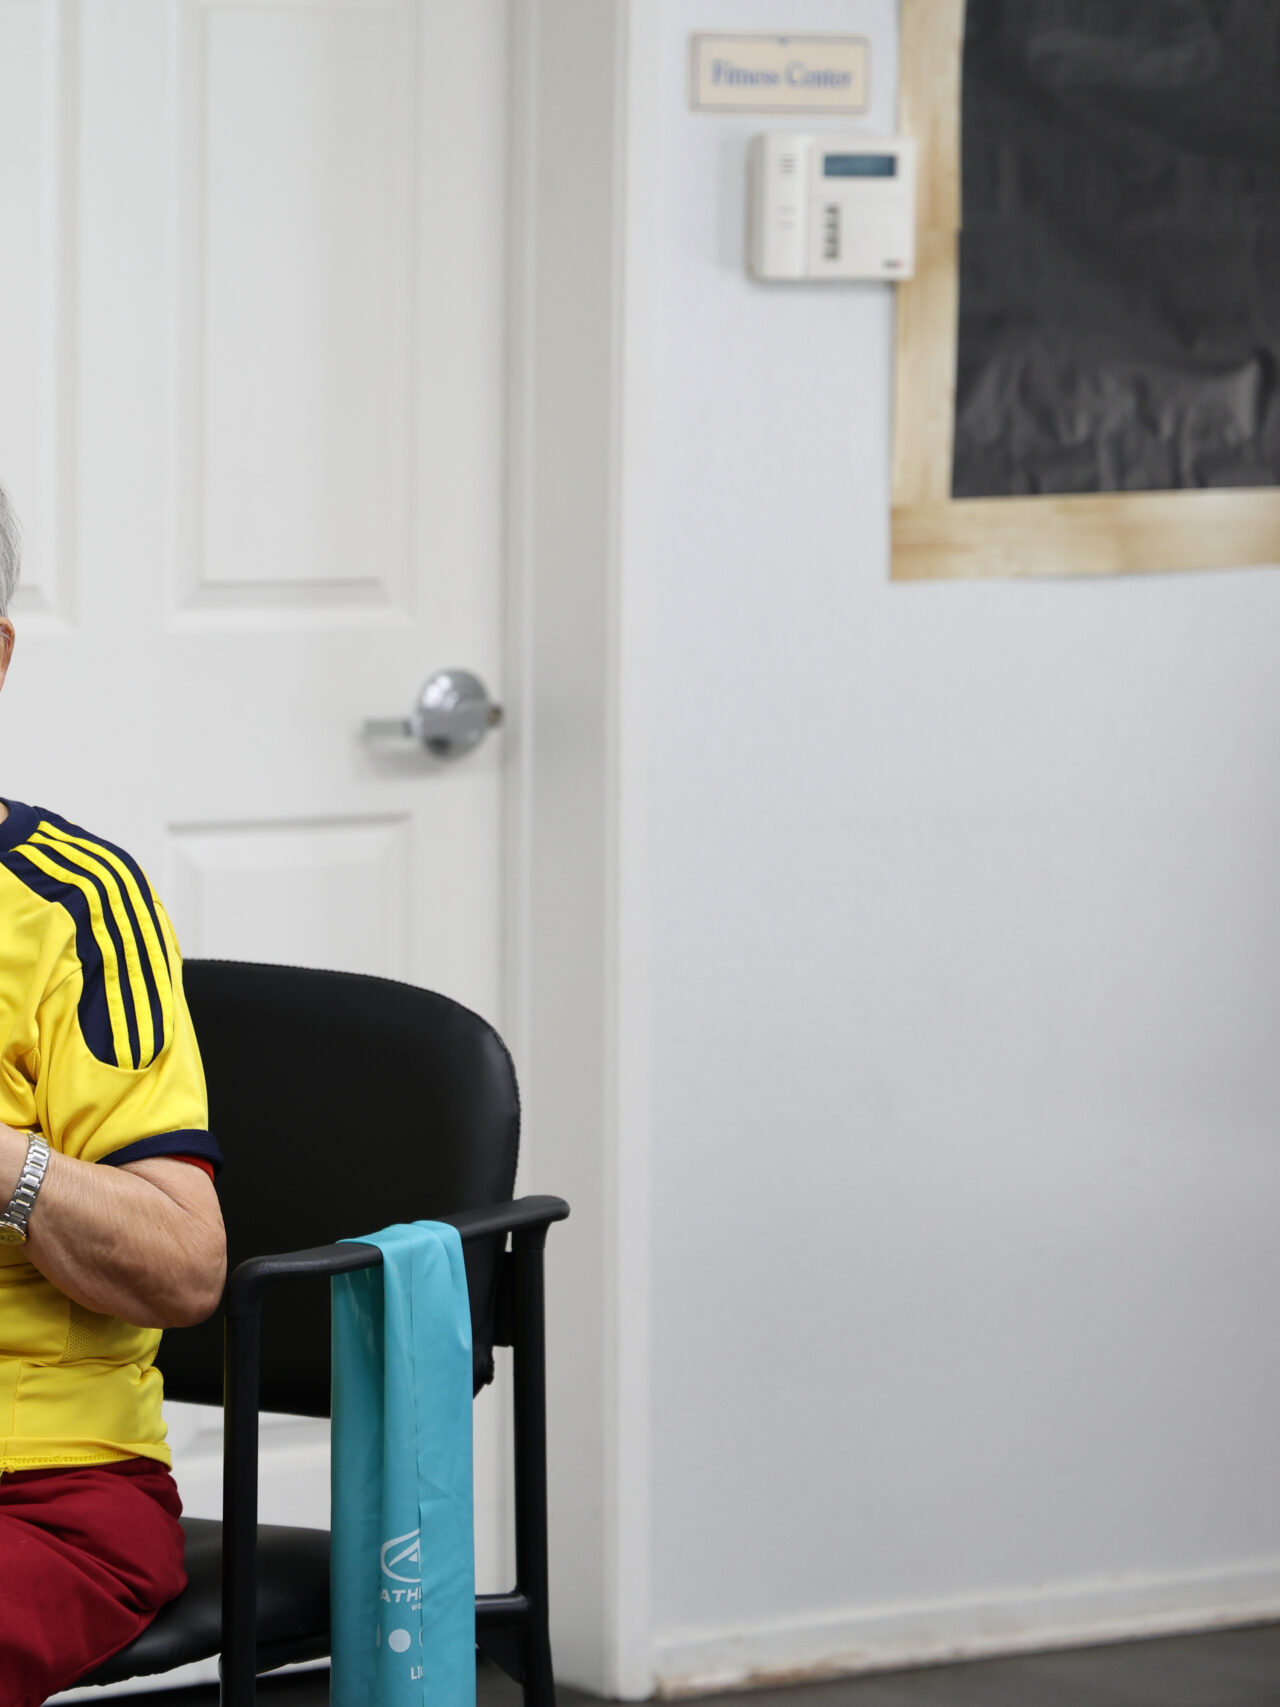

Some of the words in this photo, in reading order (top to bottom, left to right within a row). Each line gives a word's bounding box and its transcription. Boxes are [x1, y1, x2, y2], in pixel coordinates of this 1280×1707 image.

[711, 57, 779, 86] Fitness
[784, 60, 852, 88] Center
[410, 1665, 424, 1681] LI
